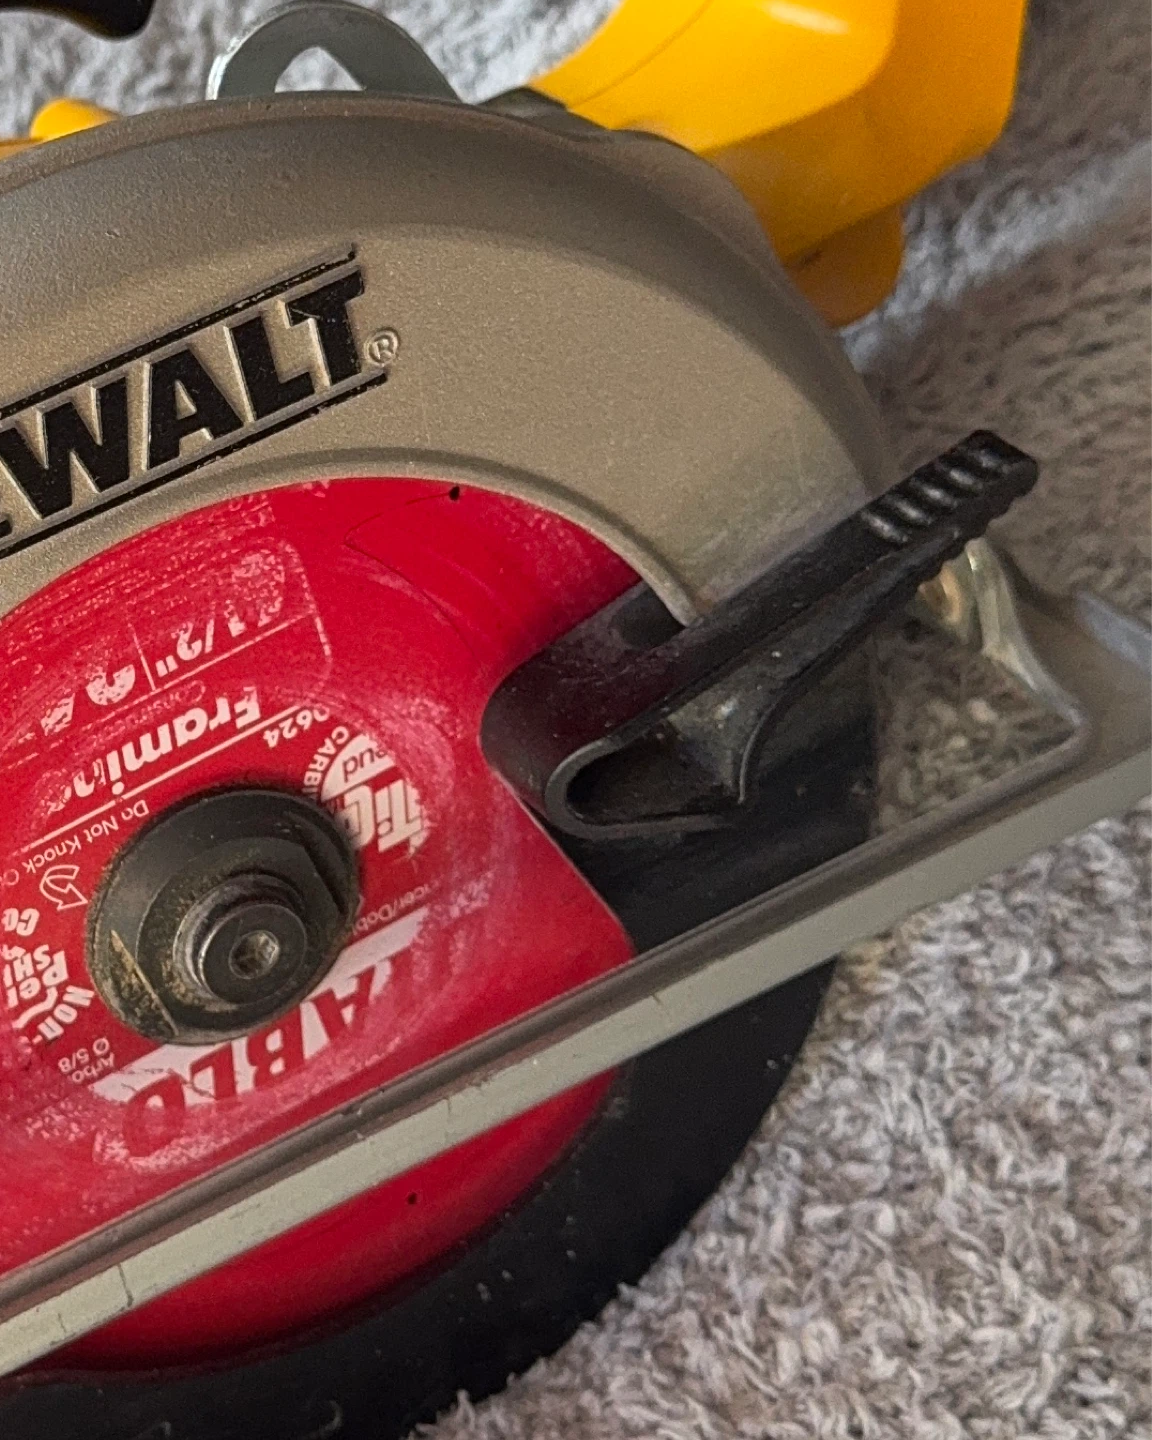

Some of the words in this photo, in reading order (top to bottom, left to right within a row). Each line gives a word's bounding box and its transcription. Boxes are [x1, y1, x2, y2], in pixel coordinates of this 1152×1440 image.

[302, 726, 349, 798] CARBI
[121, 799, 150, 821] Do
[83, 819, 119, 844] Not
[22, 834, 82, 875] Knock
[71, 1052, 116, 1083] Arbo
